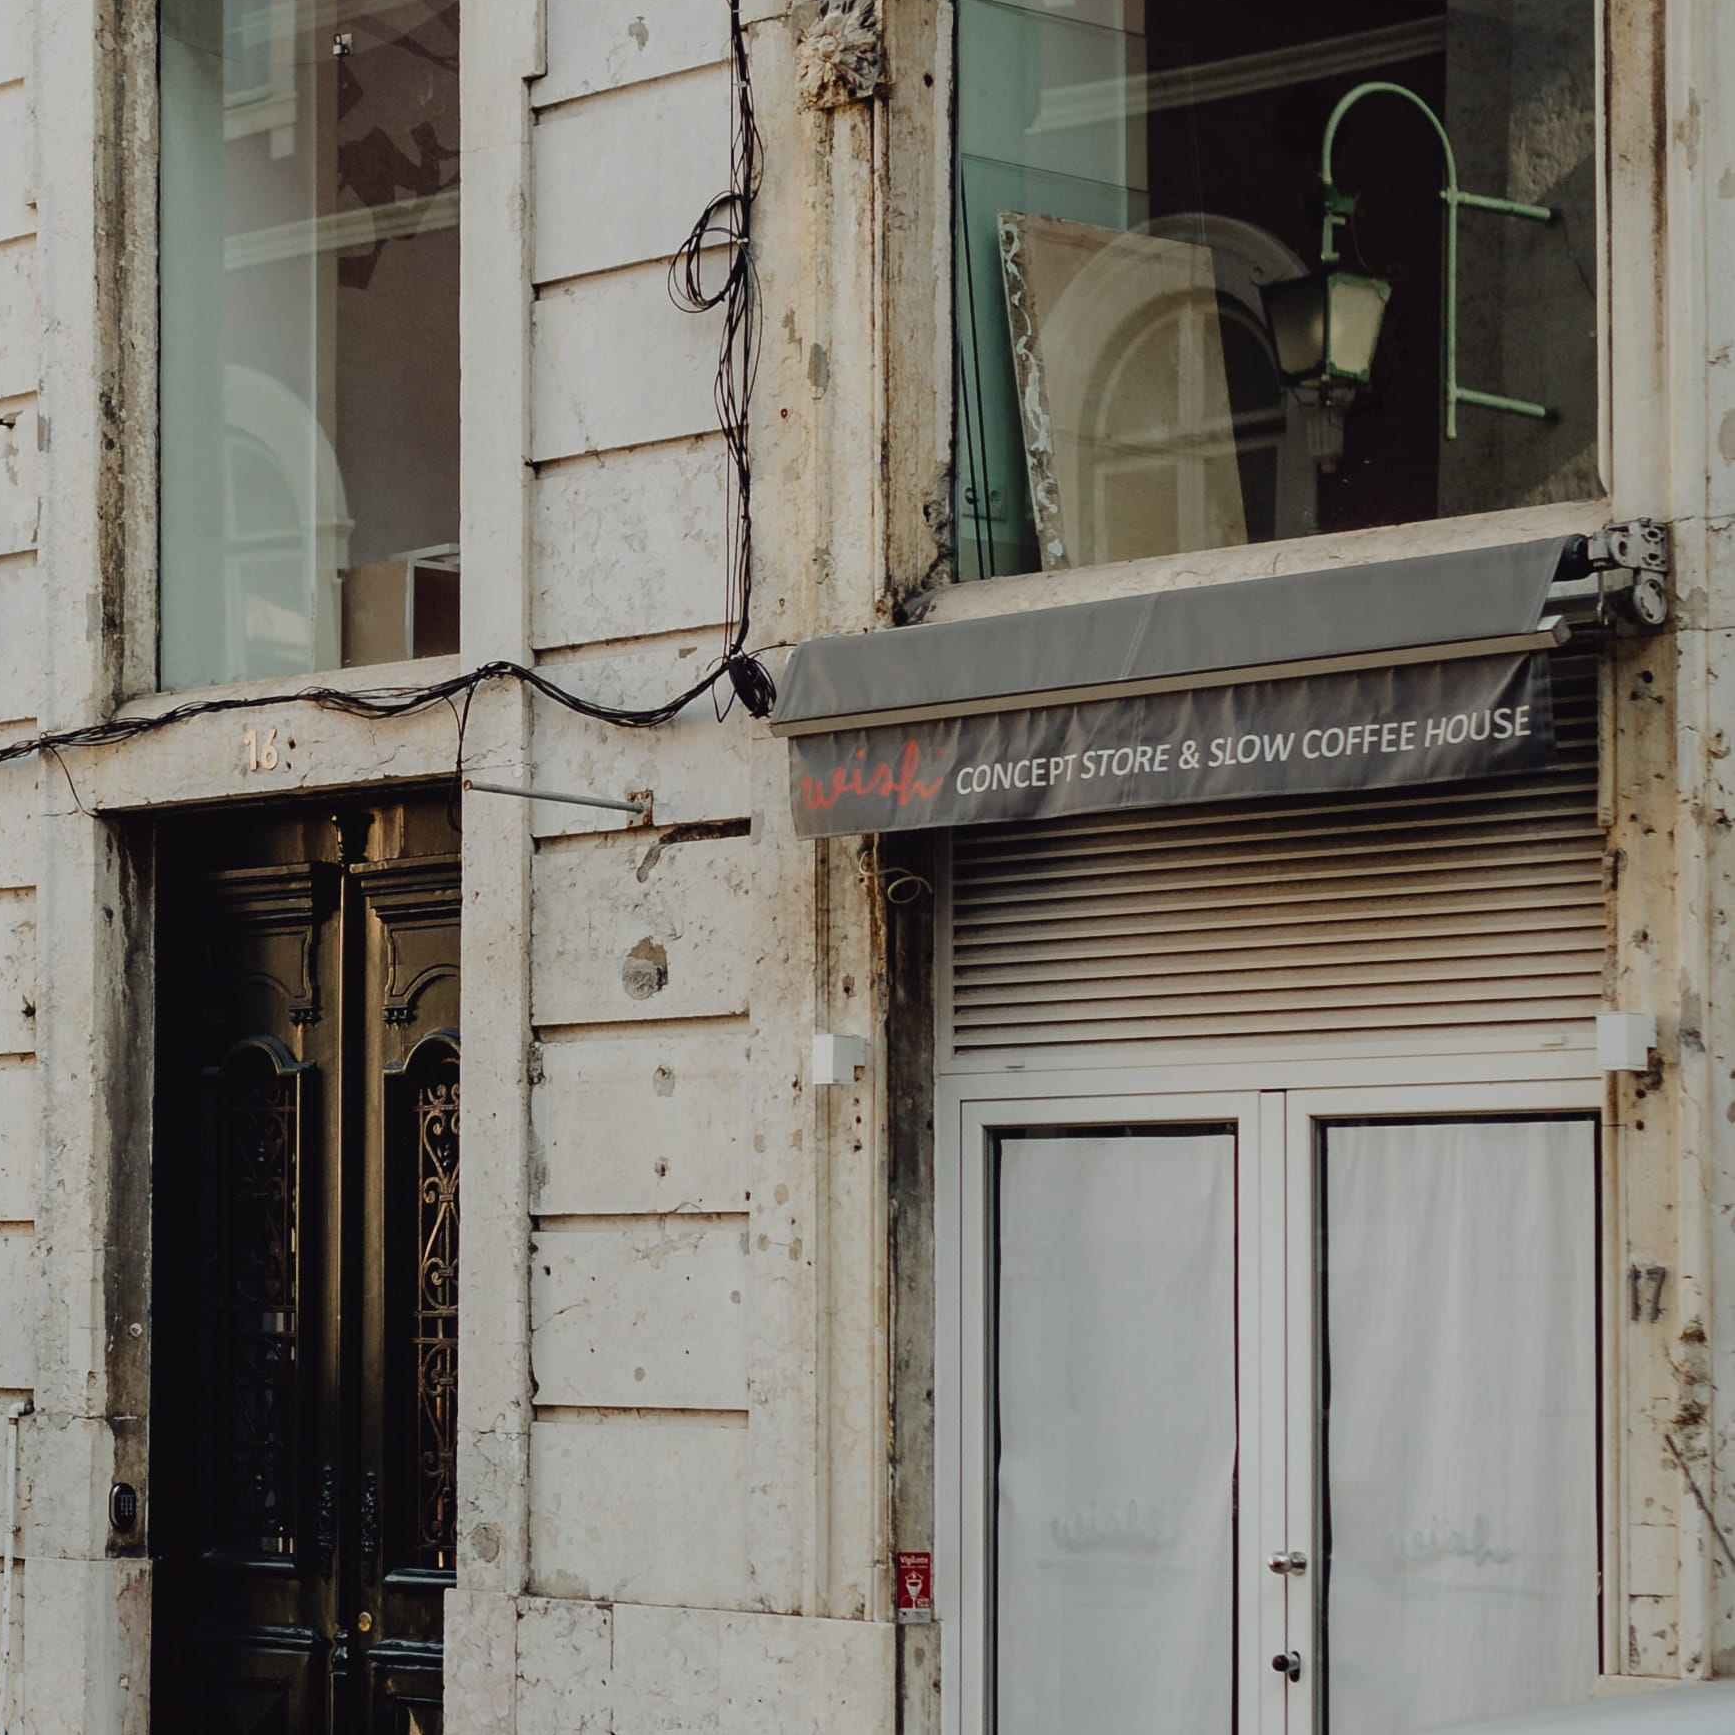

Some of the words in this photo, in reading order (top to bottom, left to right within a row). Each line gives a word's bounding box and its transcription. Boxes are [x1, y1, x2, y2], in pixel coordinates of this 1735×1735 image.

[242, 727, 279, 772] 16
[800, 739, 946, 810] wish
[955, 753, 1078, 795] CONCEPT
[1080, 744, 1171, 780] STORE
[1178, 740, 1201, 771] &
[1207, 731, 1295, 768] SLOW
[1301, 720, 1418, 760] COFFEE
[1423, 704, 1532, 748] HOUSE
[1630, 1264, 1666, 1324] 17
